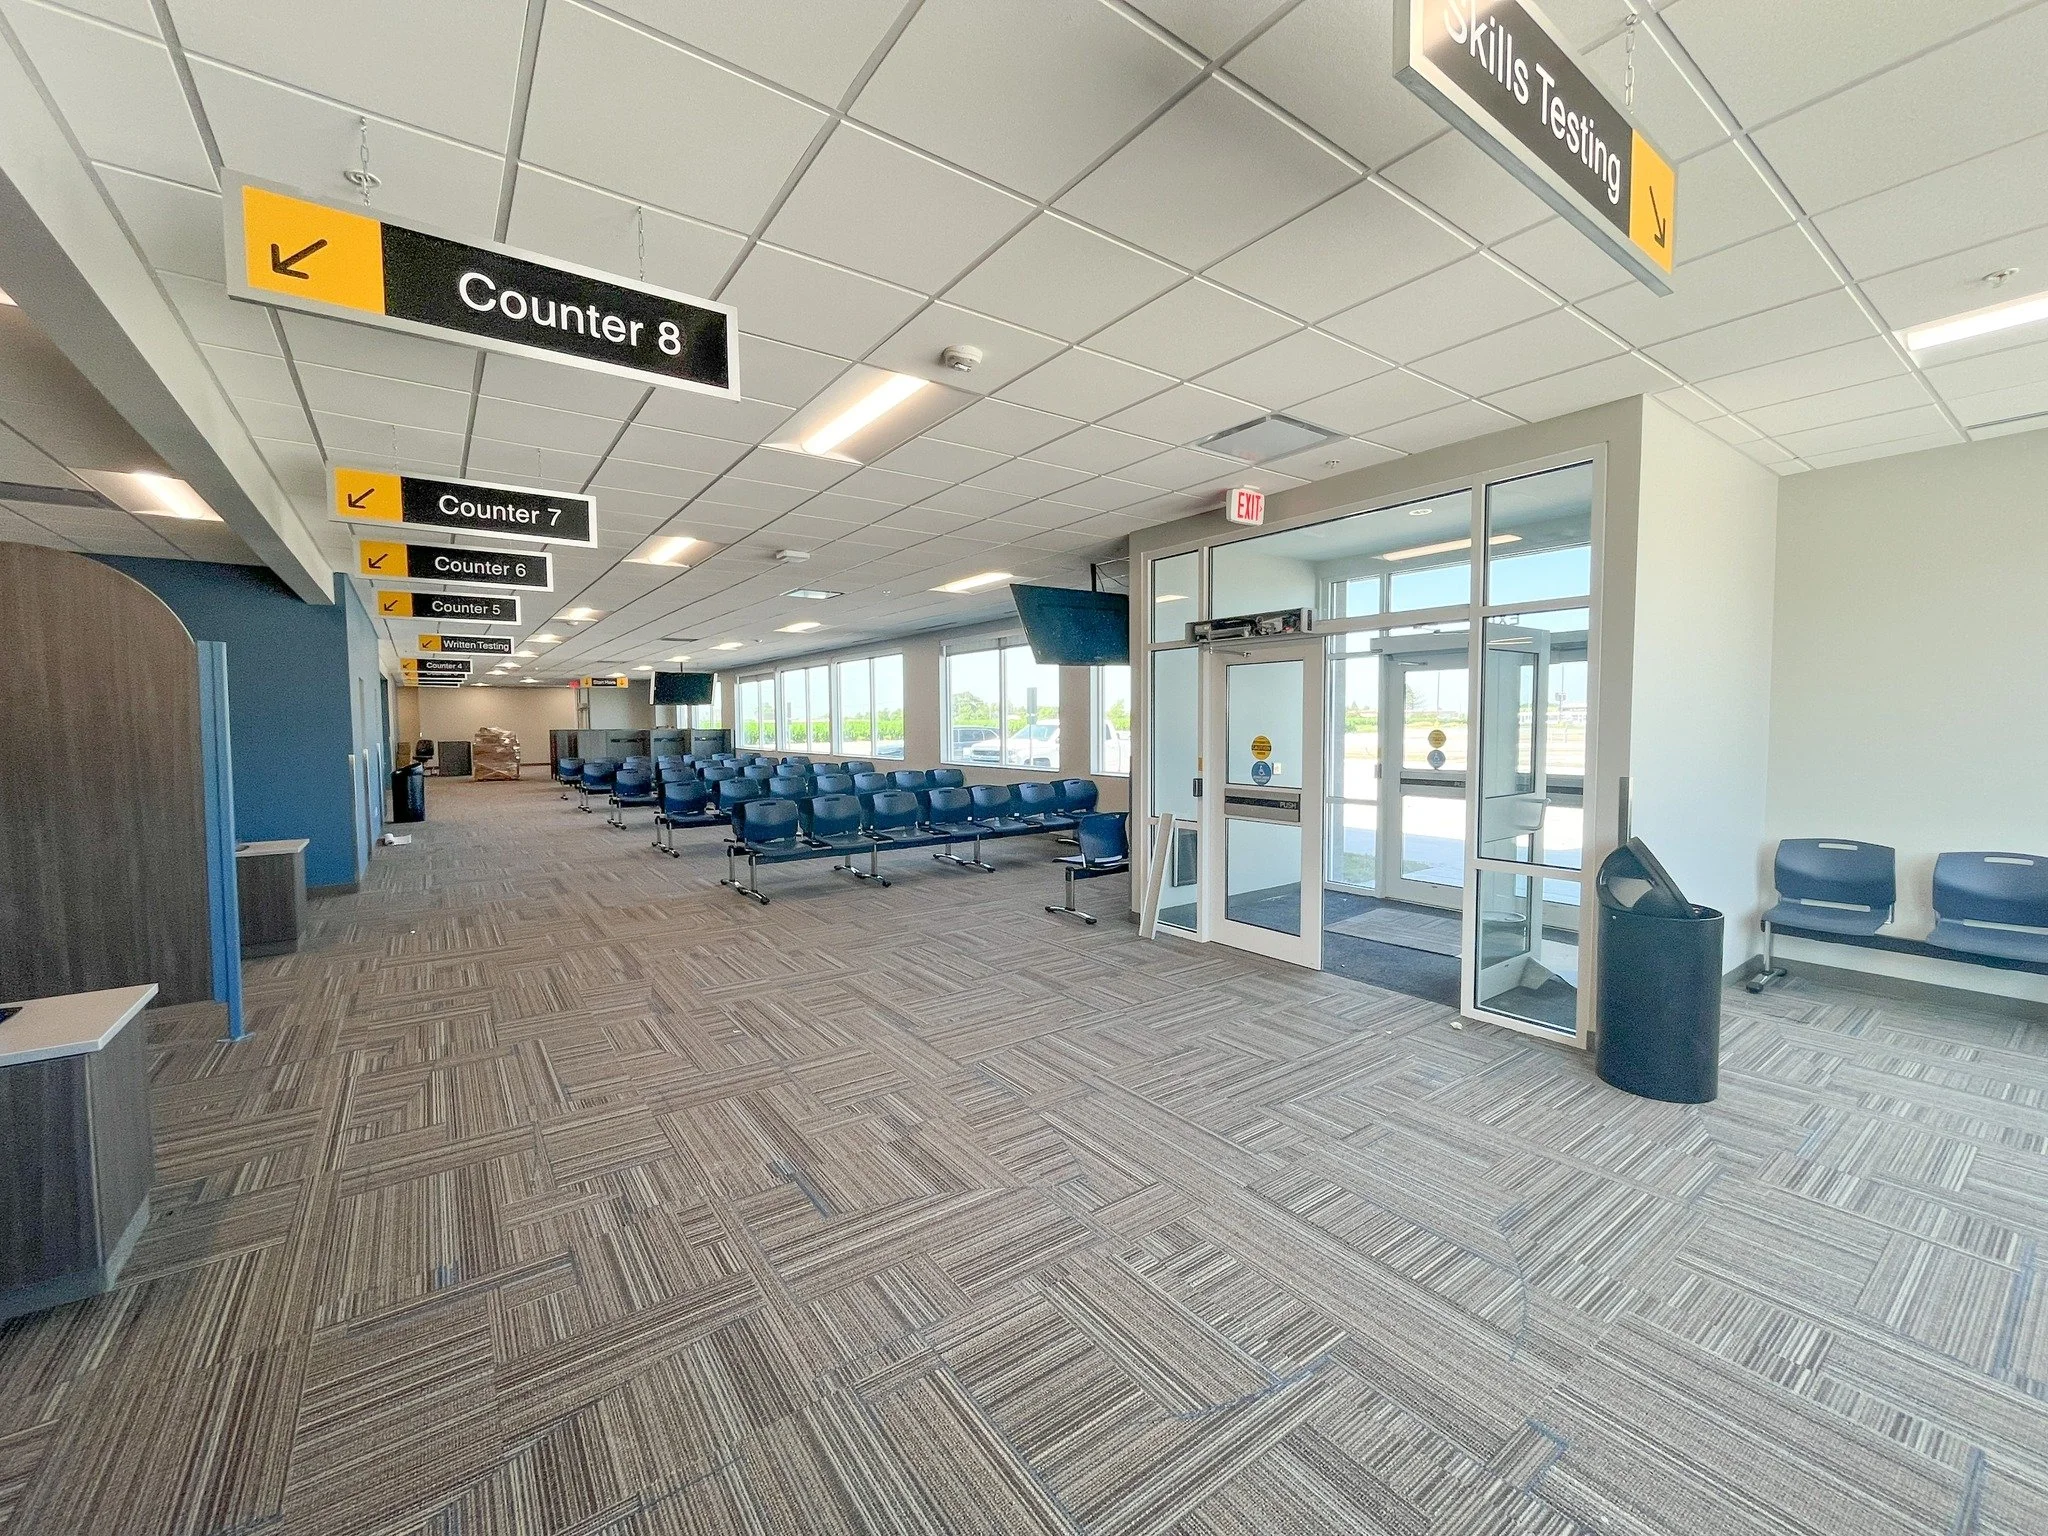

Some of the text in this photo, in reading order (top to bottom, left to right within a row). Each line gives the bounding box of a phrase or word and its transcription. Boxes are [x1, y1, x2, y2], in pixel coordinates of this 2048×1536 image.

[1443, 0, 1621, 205] Skills Testing
[458, 272, 682, 356] Counter 8
[438, 494, 562, 527] Counter 7
[1237, 491, 1261, 520] EXIT
[434, 556, 527, 578] Counter 6
[431, 600, 501, 615] Counter 5
[443, 640, 509, 652] Written Testing
[1279, 801, 1297, 809] PUSH
